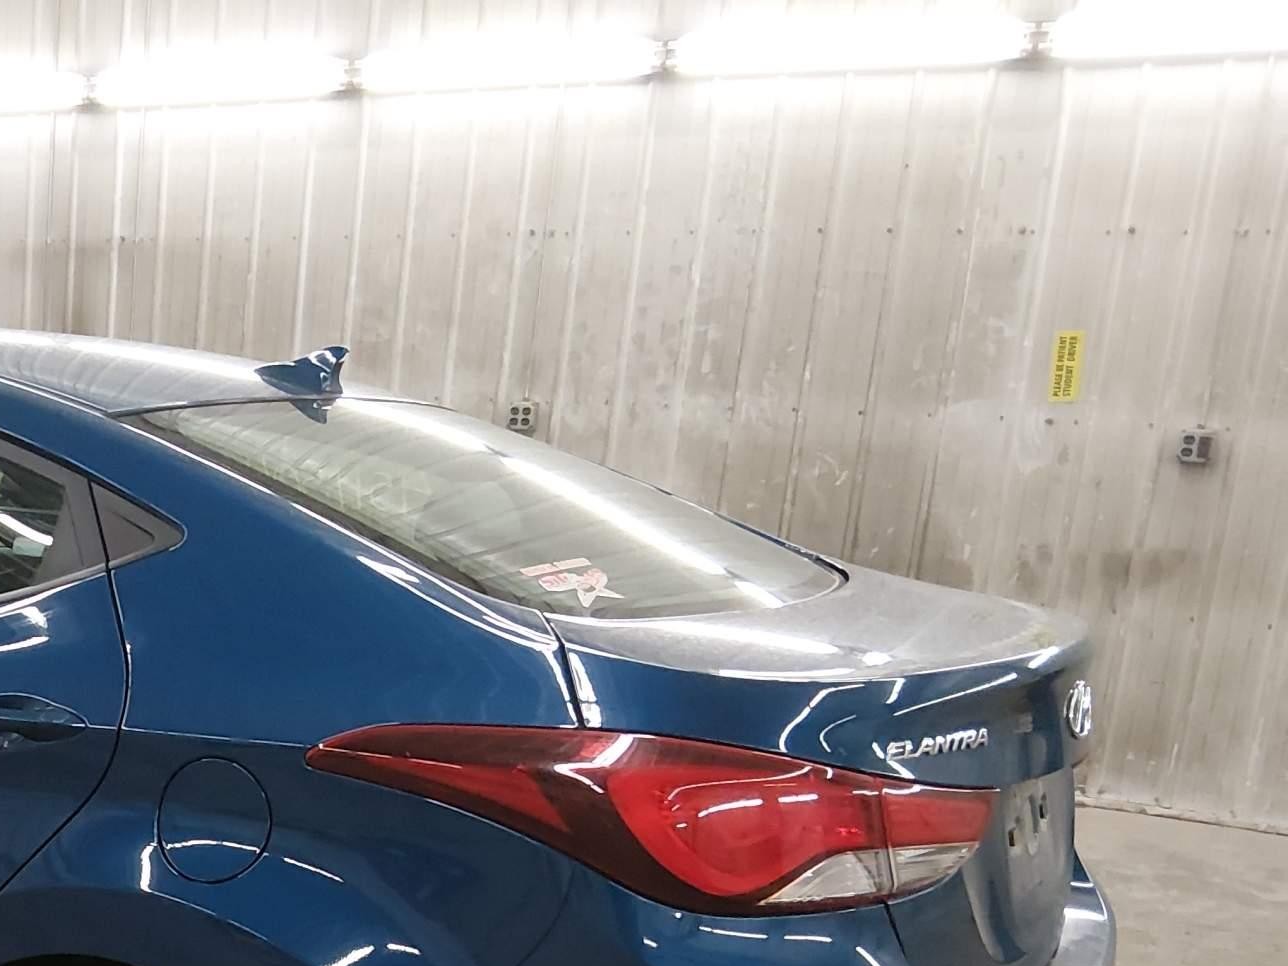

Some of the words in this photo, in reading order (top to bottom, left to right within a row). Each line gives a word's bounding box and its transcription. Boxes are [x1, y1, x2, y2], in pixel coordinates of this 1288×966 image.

[1056, 336, 1068, 363] PATIENT
[1066, 336, 1078, 362] DRIVER
[1052, 374, 1063, 397] PLEASE
[1062, 365, 1074, 397] STUDENT
[886, 727, 989, 761] ELANTRA
